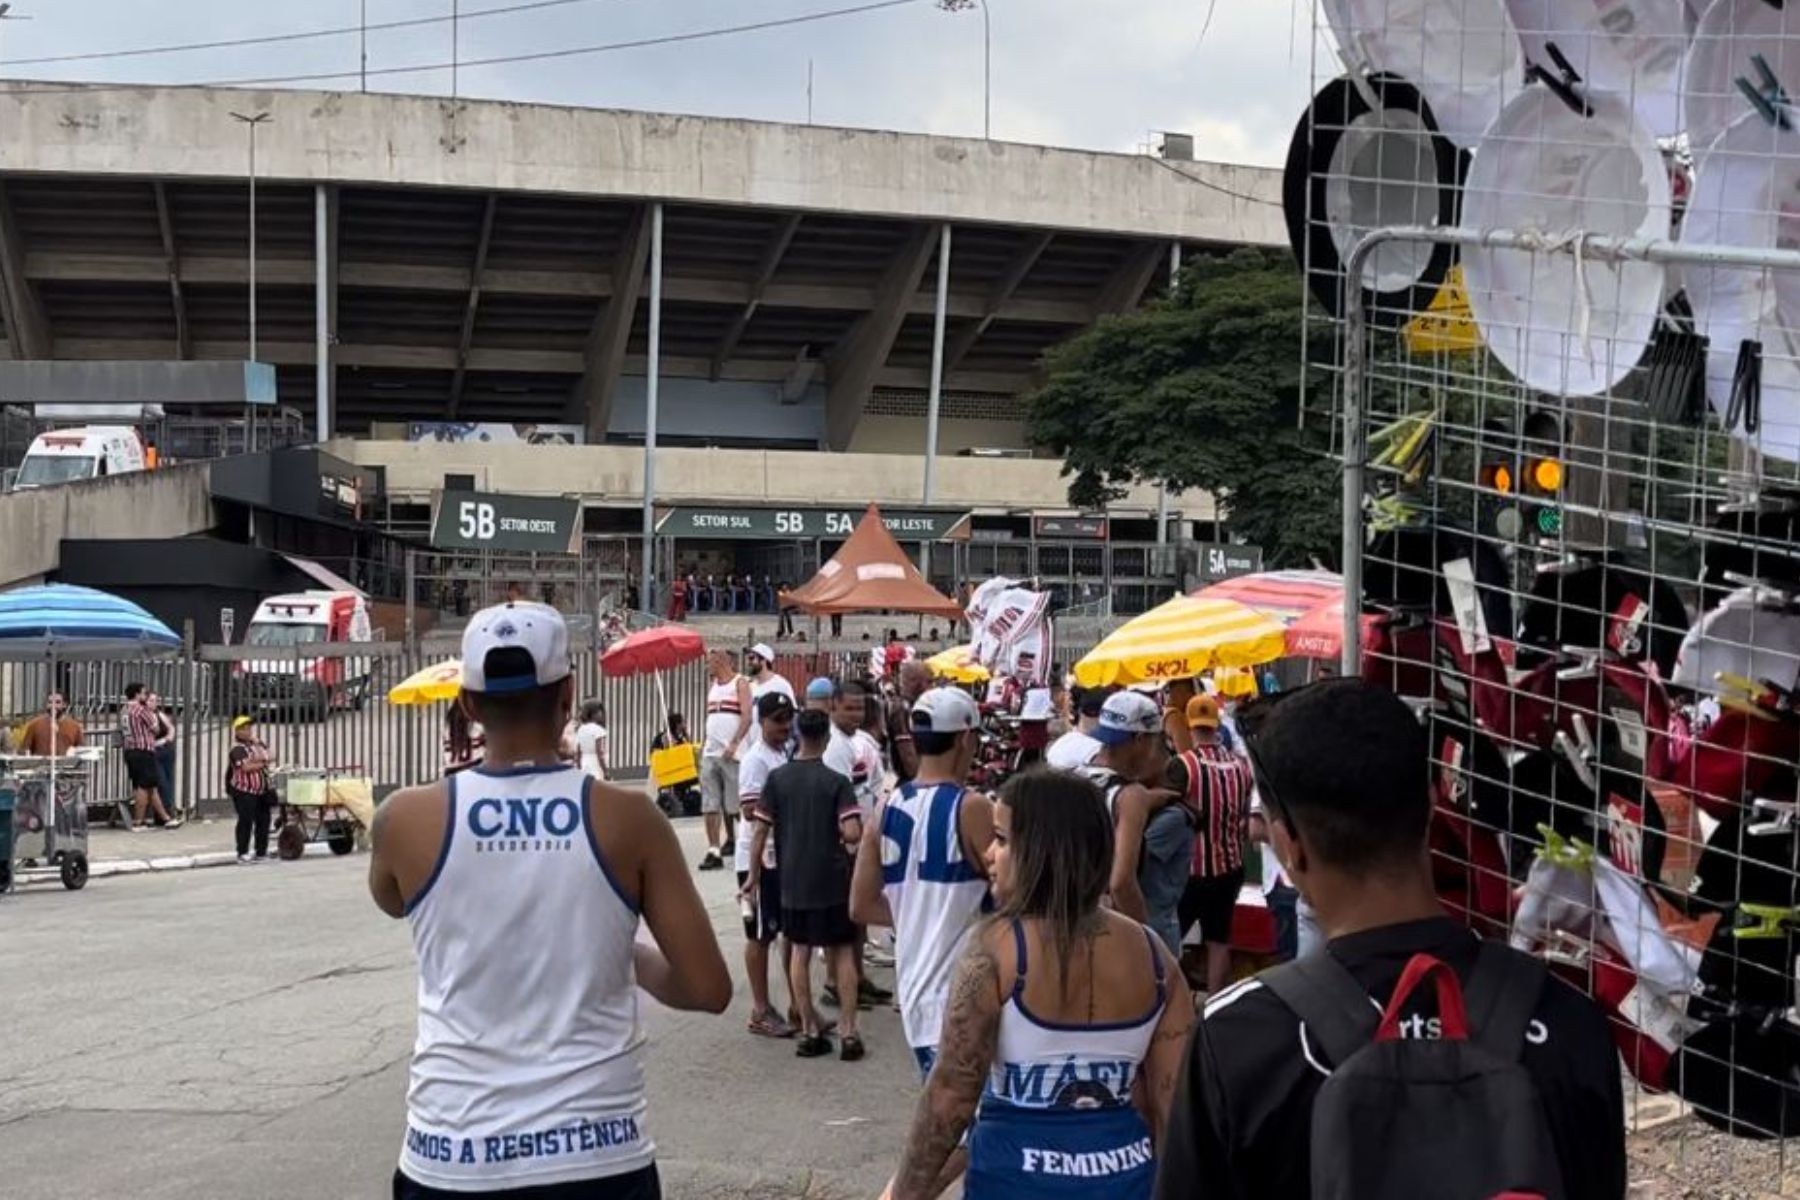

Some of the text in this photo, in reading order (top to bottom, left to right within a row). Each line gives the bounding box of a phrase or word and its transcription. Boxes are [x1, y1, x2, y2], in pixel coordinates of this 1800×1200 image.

[459, 501, 556, 539] 5B SETOR OESTE
[692, 514, 728, 527] SETOR
[775, 512, 803, 532] 5B
[825, 512, 854, 533] 5A
[902, 519, 934, 530] LESTE
[1210, 549, 1226, 574] 5A
[1144, 658, 1190, 677] SKOL
[468, 798, 580, 838] CNO
[459, 1138, 475, 1163] A
[484, 1114, 639, 1164] RESISTÊNCIA
